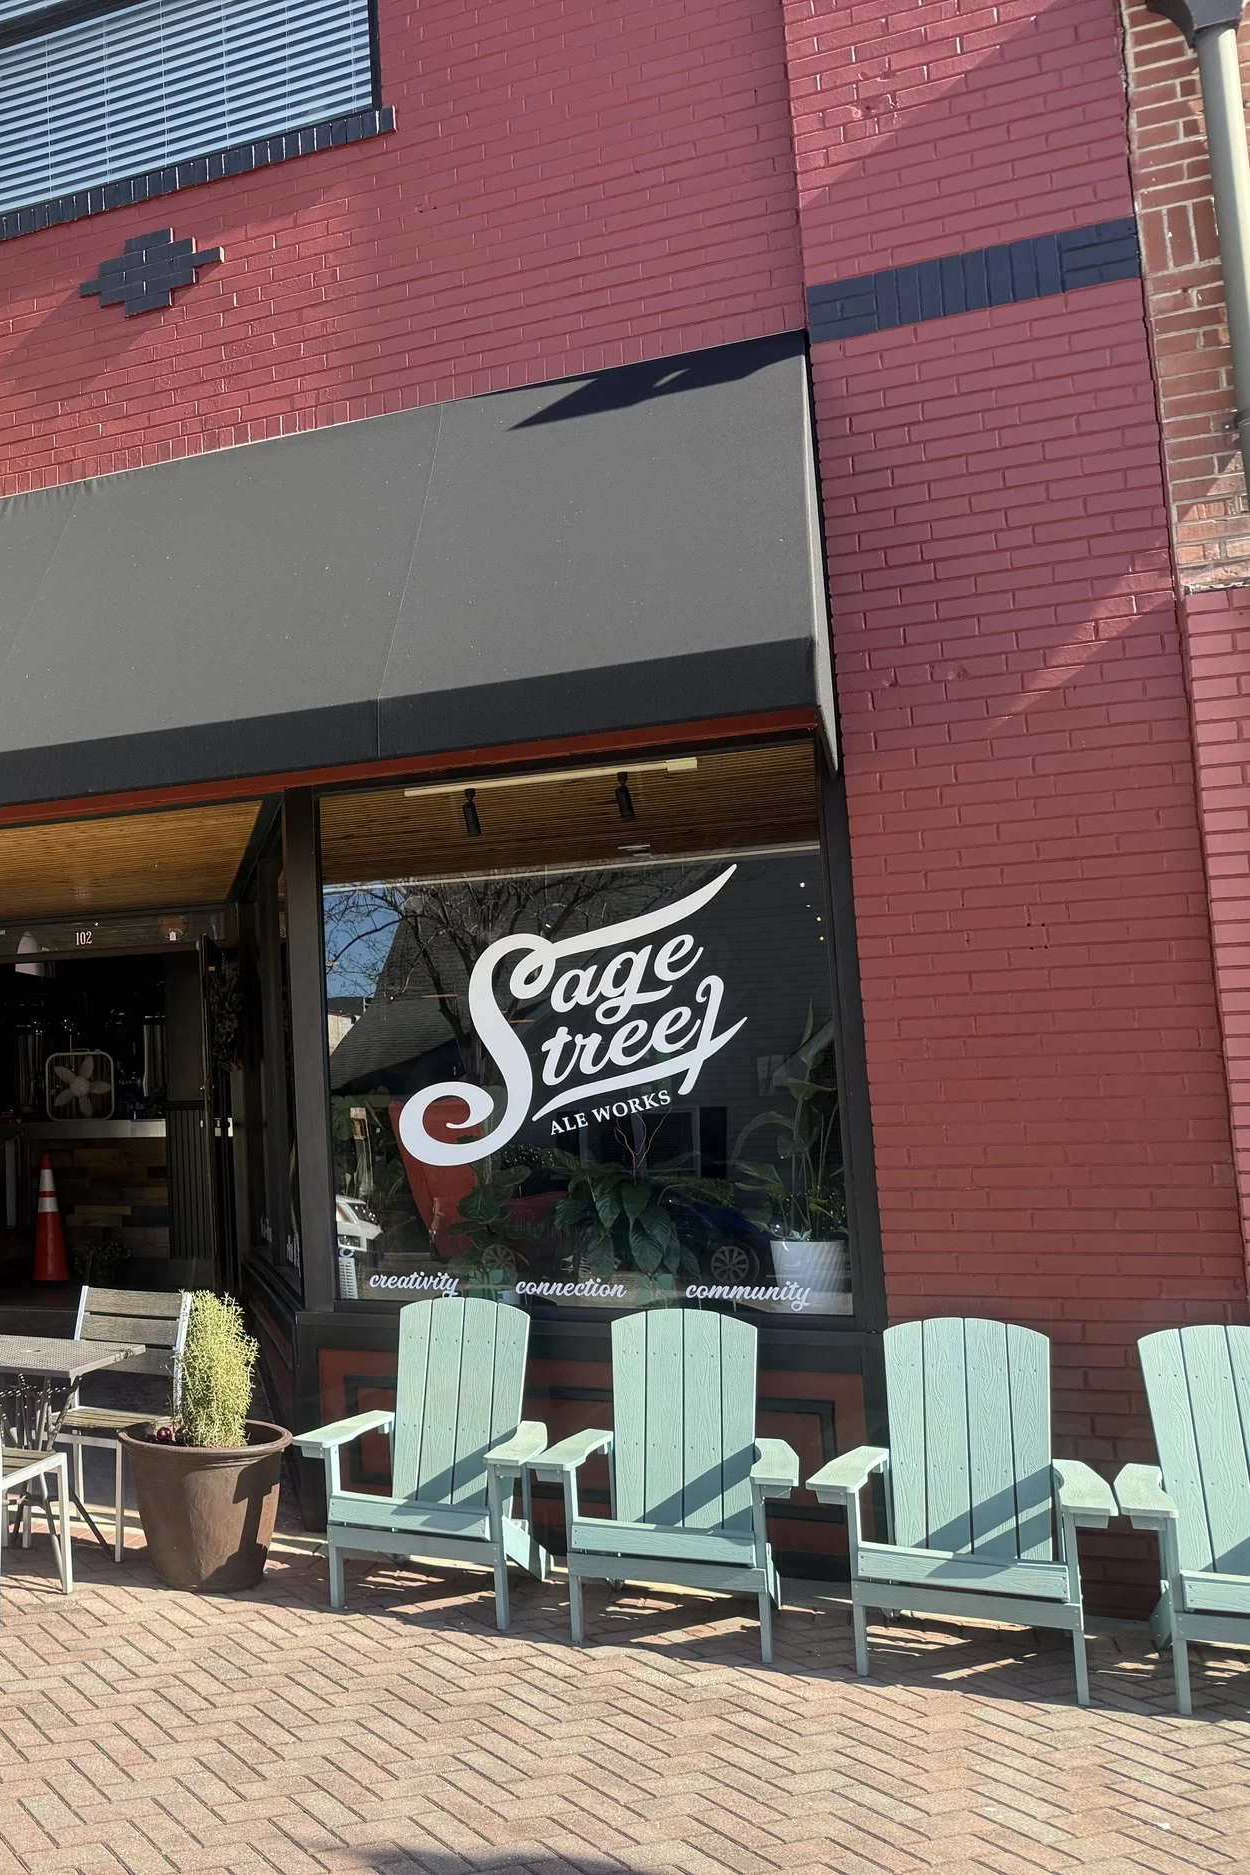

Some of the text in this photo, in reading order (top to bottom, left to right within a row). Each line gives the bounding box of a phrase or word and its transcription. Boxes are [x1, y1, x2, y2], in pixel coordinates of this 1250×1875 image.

[75, 931, 92, 946] 102
[550, 1089, 671, 1135] ALE WORKS
[369, 1272, 811, 1312] creativity connection community
